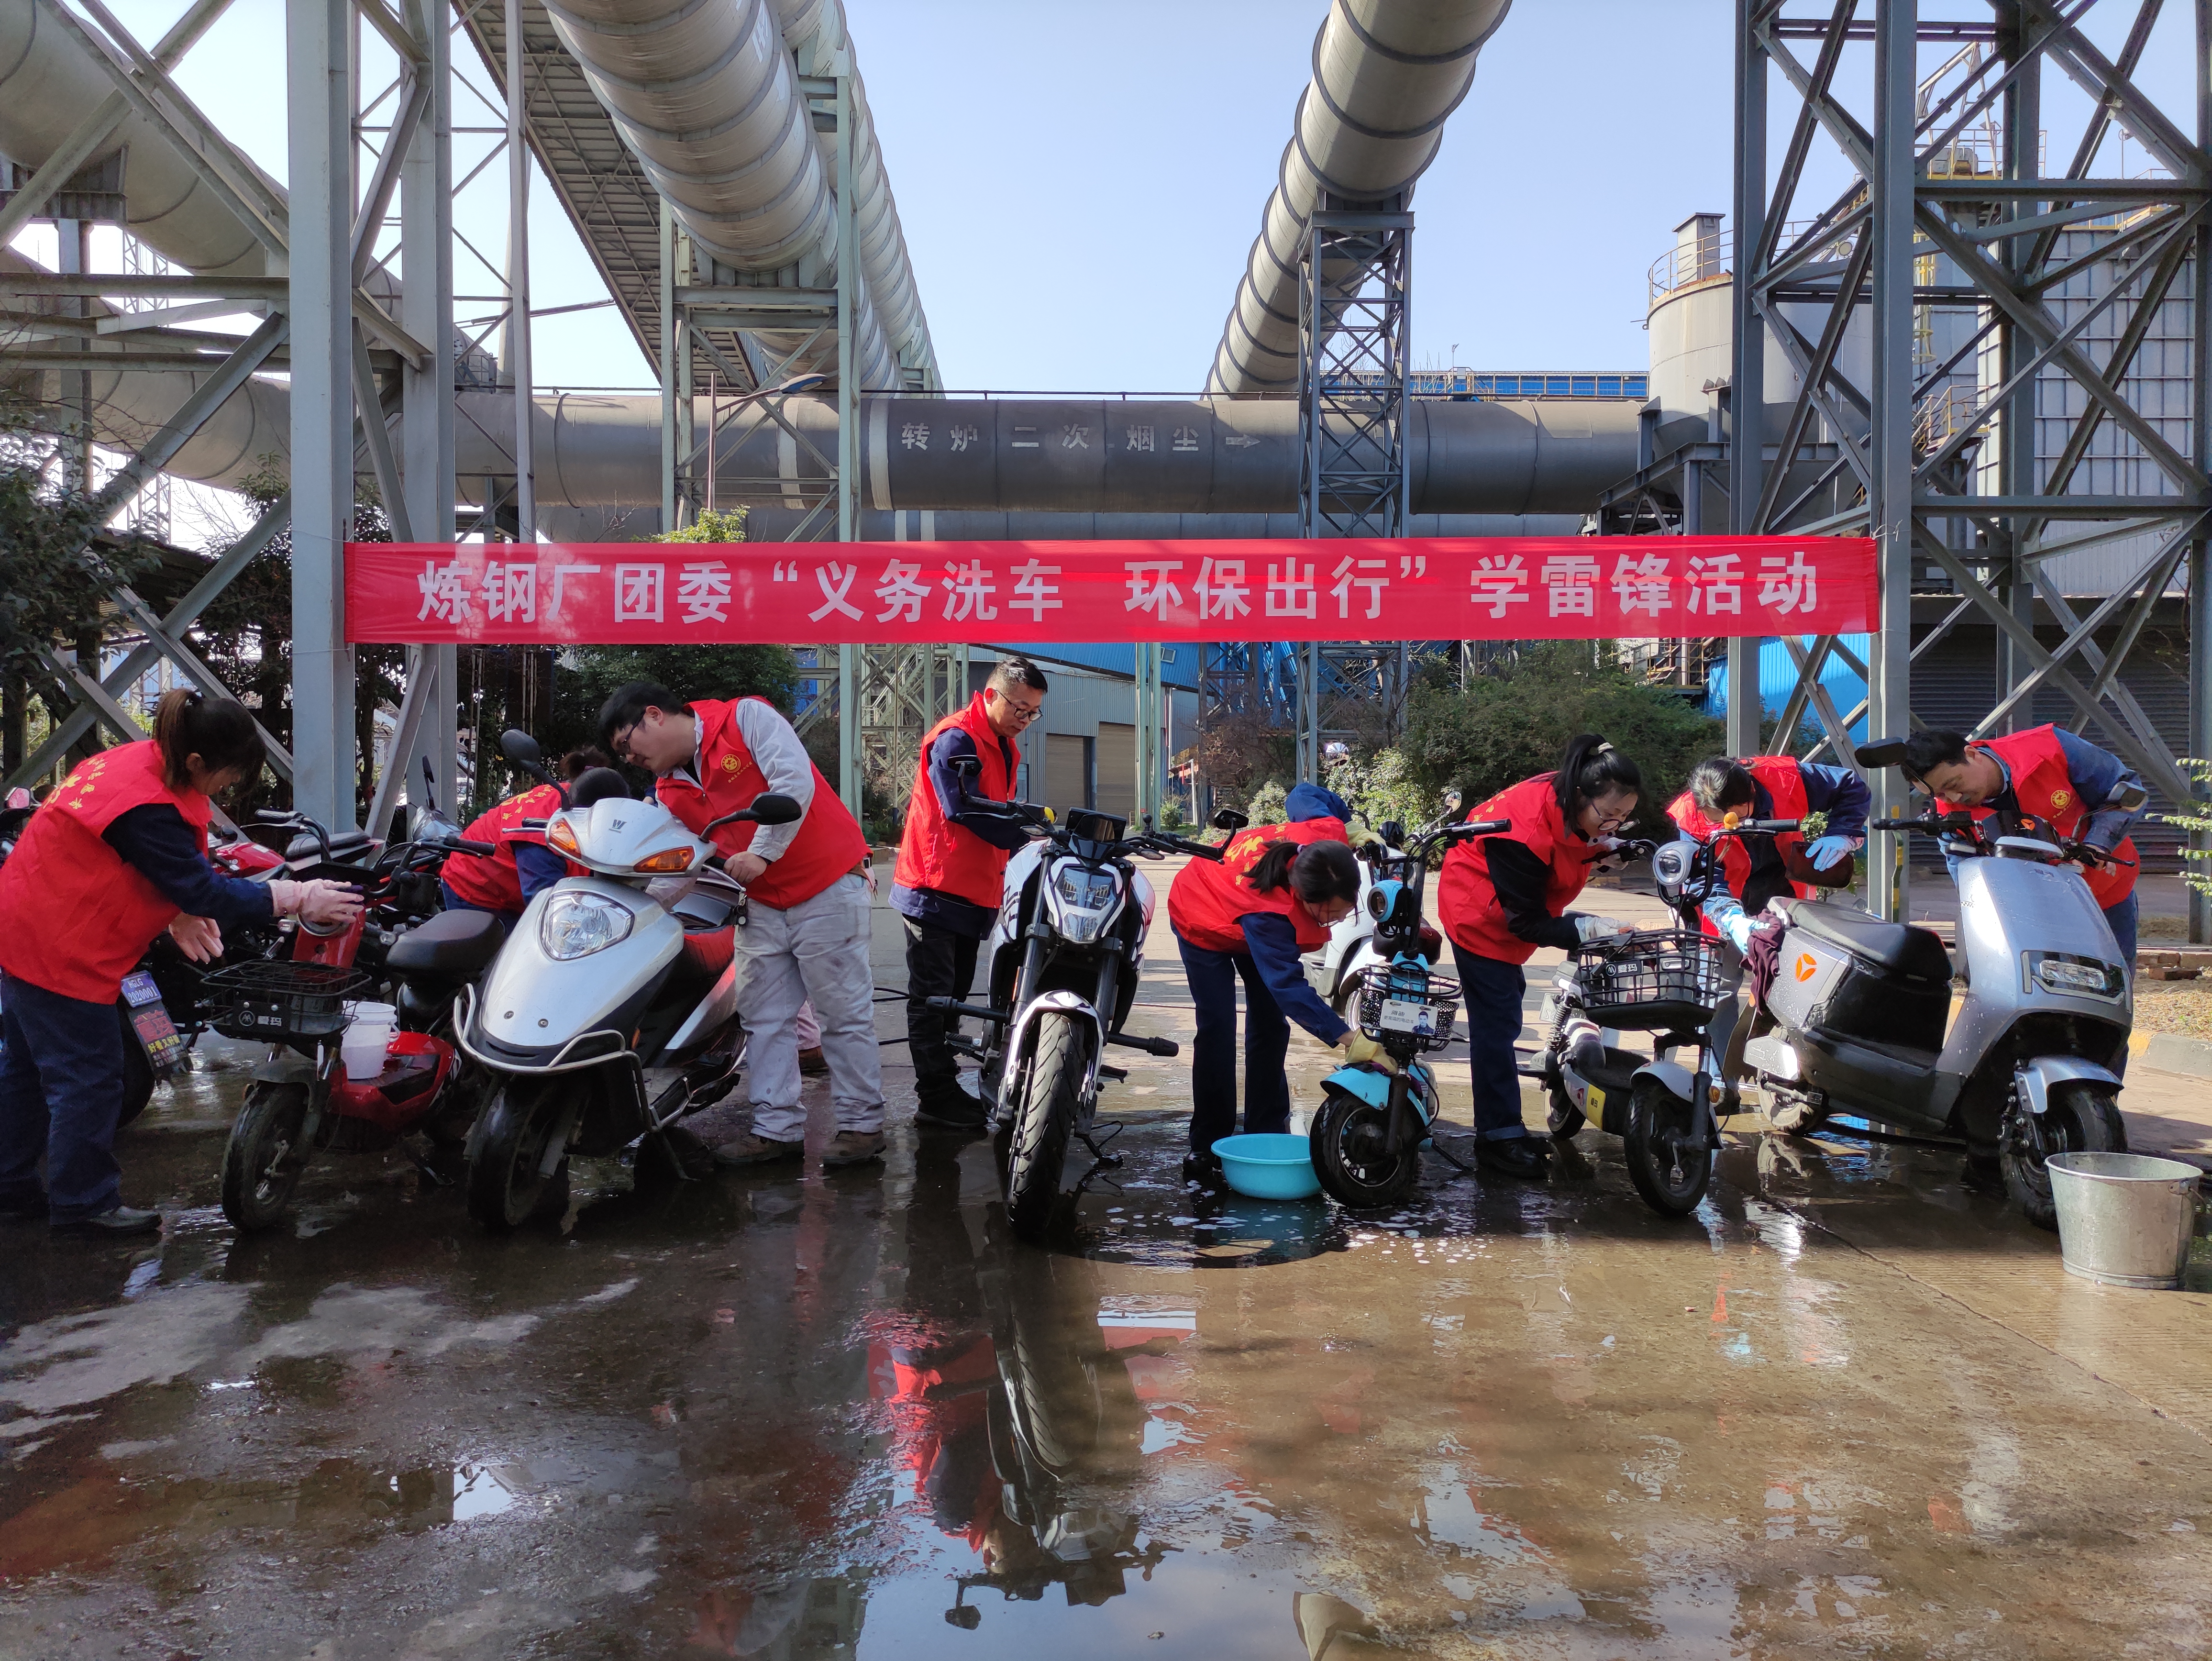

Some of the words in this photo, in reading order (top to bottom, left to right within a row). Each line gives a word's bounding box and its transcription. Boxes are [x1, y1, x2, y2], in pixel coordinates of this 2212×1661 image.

[901, 422, 1199, 453] 转炉二次烟尘
[127, 978, 143, 989] HGLG
[128, 986, 157, 1003] 2020001
